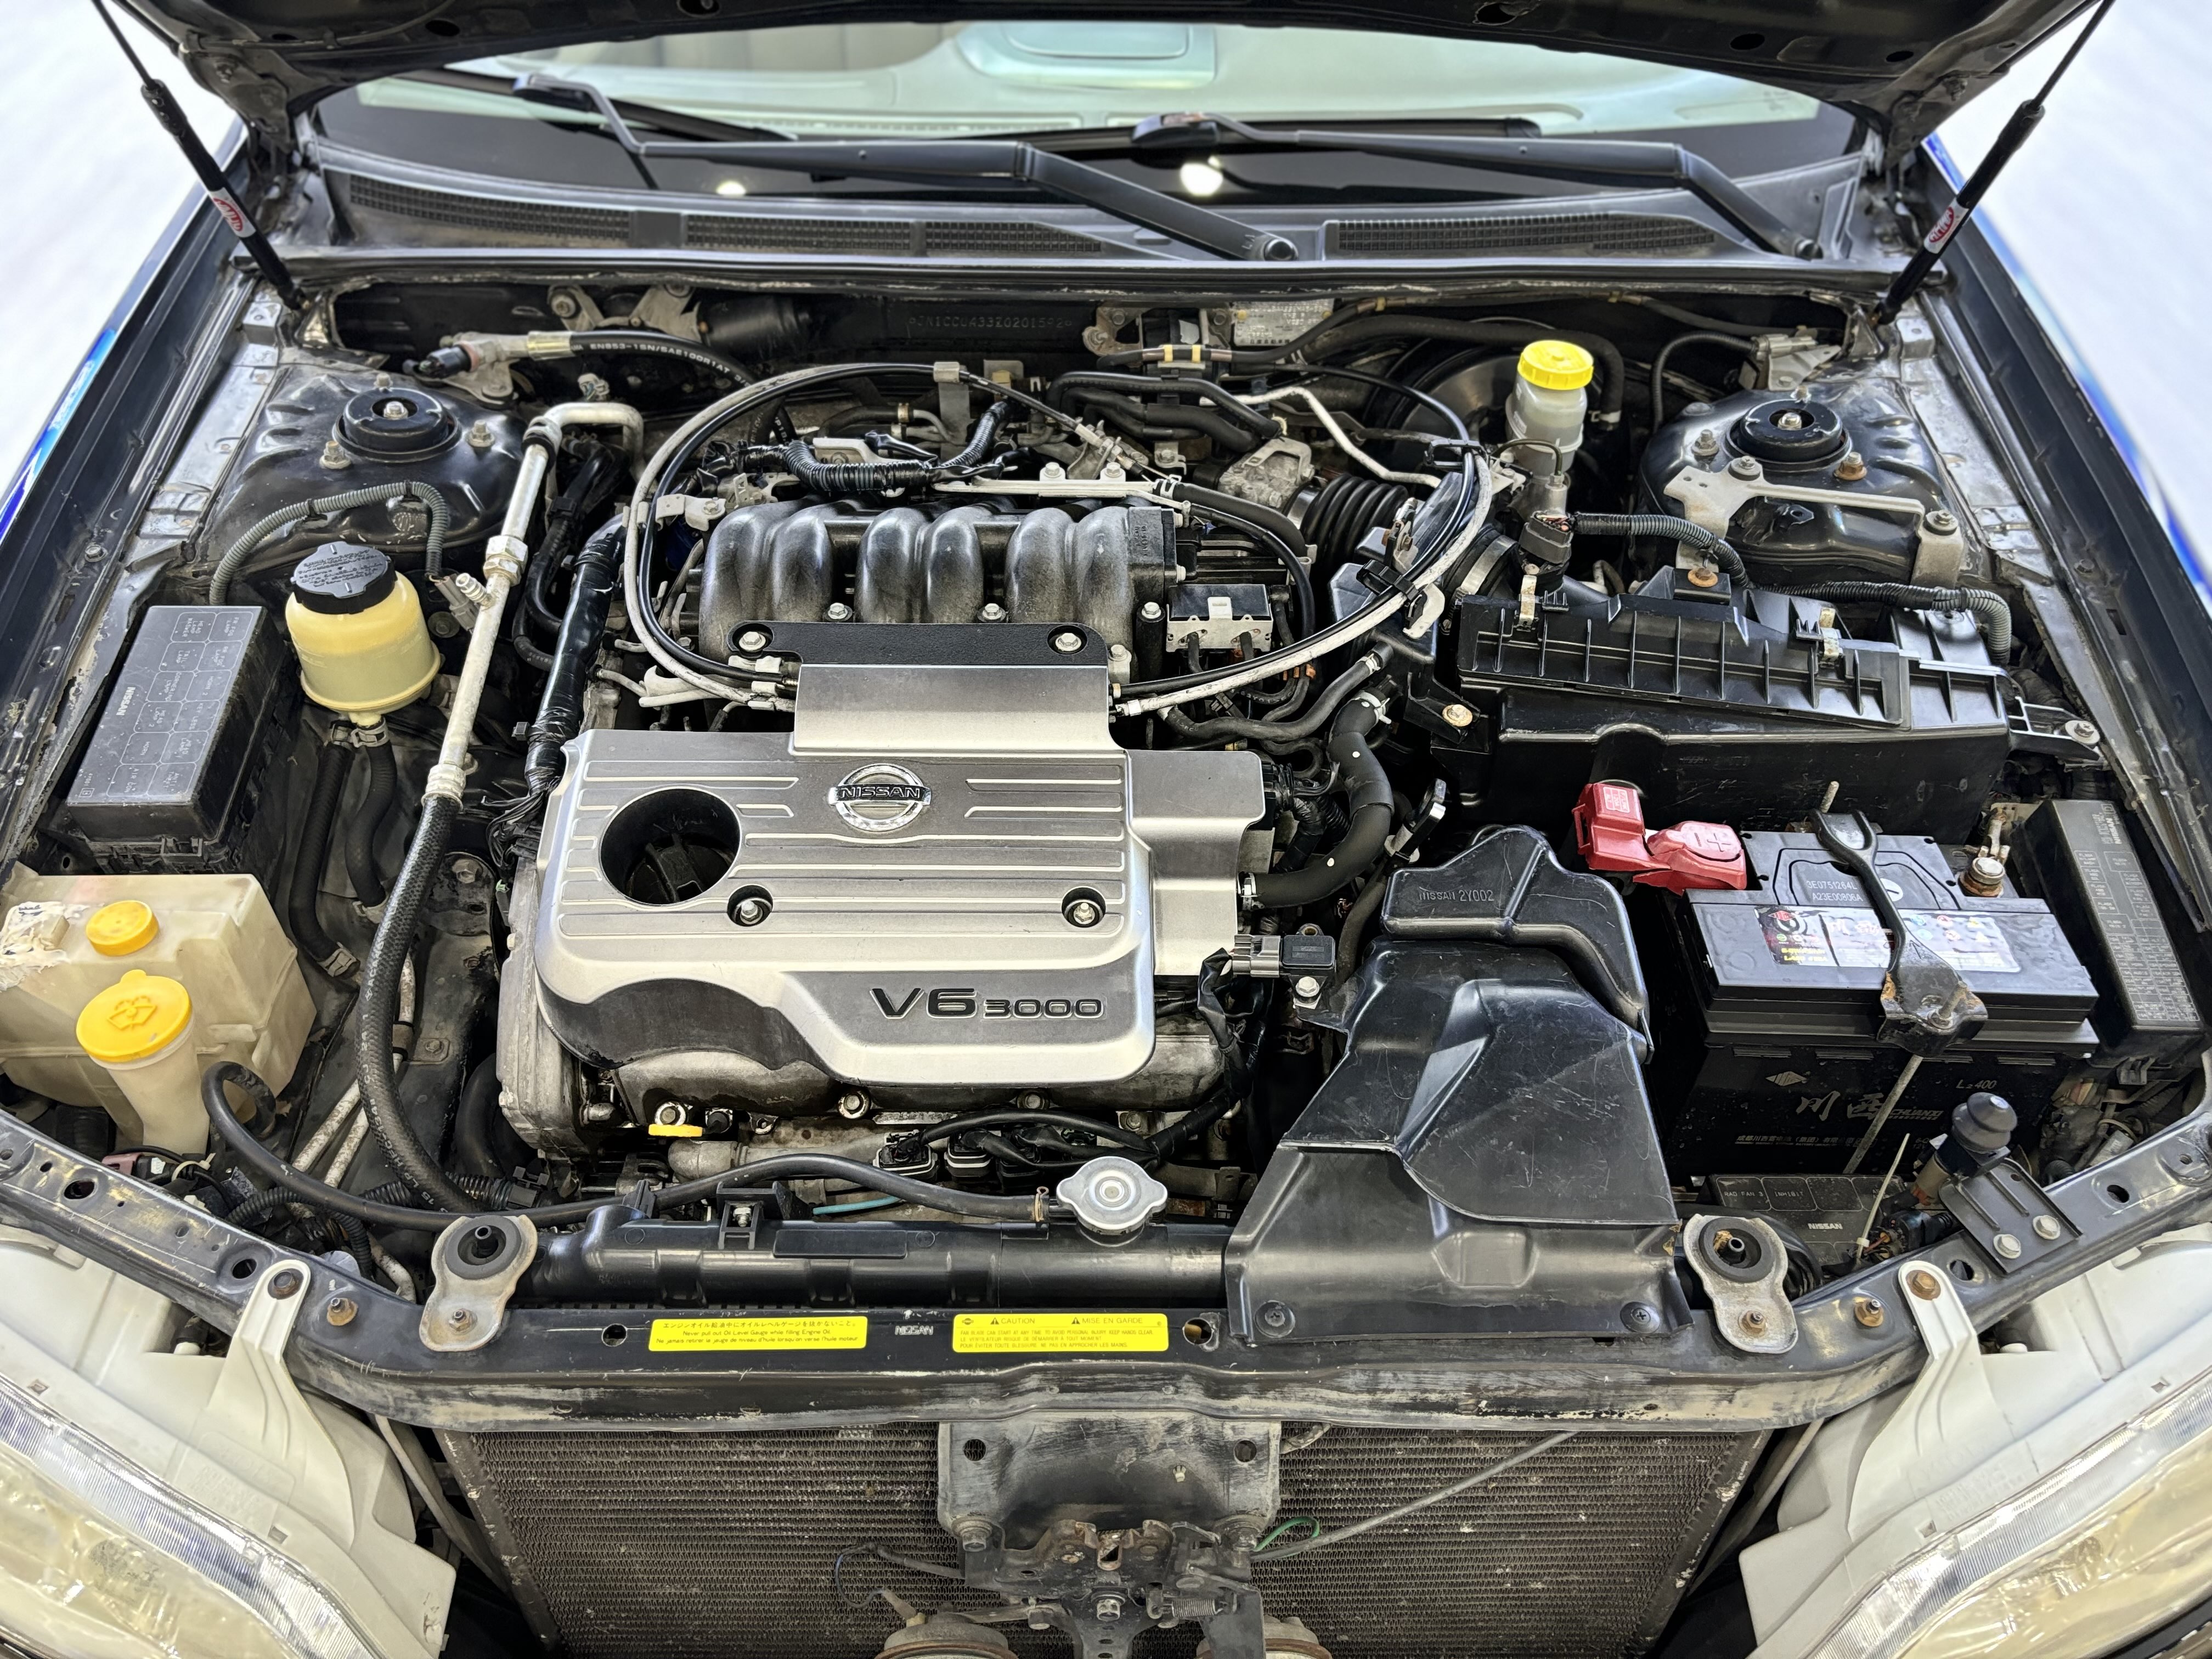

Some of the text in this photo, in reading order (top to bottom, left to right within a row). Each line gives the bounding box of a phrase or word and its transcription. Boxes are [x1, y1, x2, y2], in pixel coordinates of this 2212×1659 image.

[115, 687, 136, 715] NISSAN
[195, 703, 204, 713] KEY
[129, 769, 139, 778] AIR
[840, 786, 921, 799] NISSAN
[1419, 889, 1494, 901] NISSAN 2Y002
[870, 987, 1106, 1020] V6 3000
[1889, 1109, 1944, 1117] CHUANXI
[404, 1172, 419, 1188] LP
[895, 1325, 933, 1335] NISSAN
